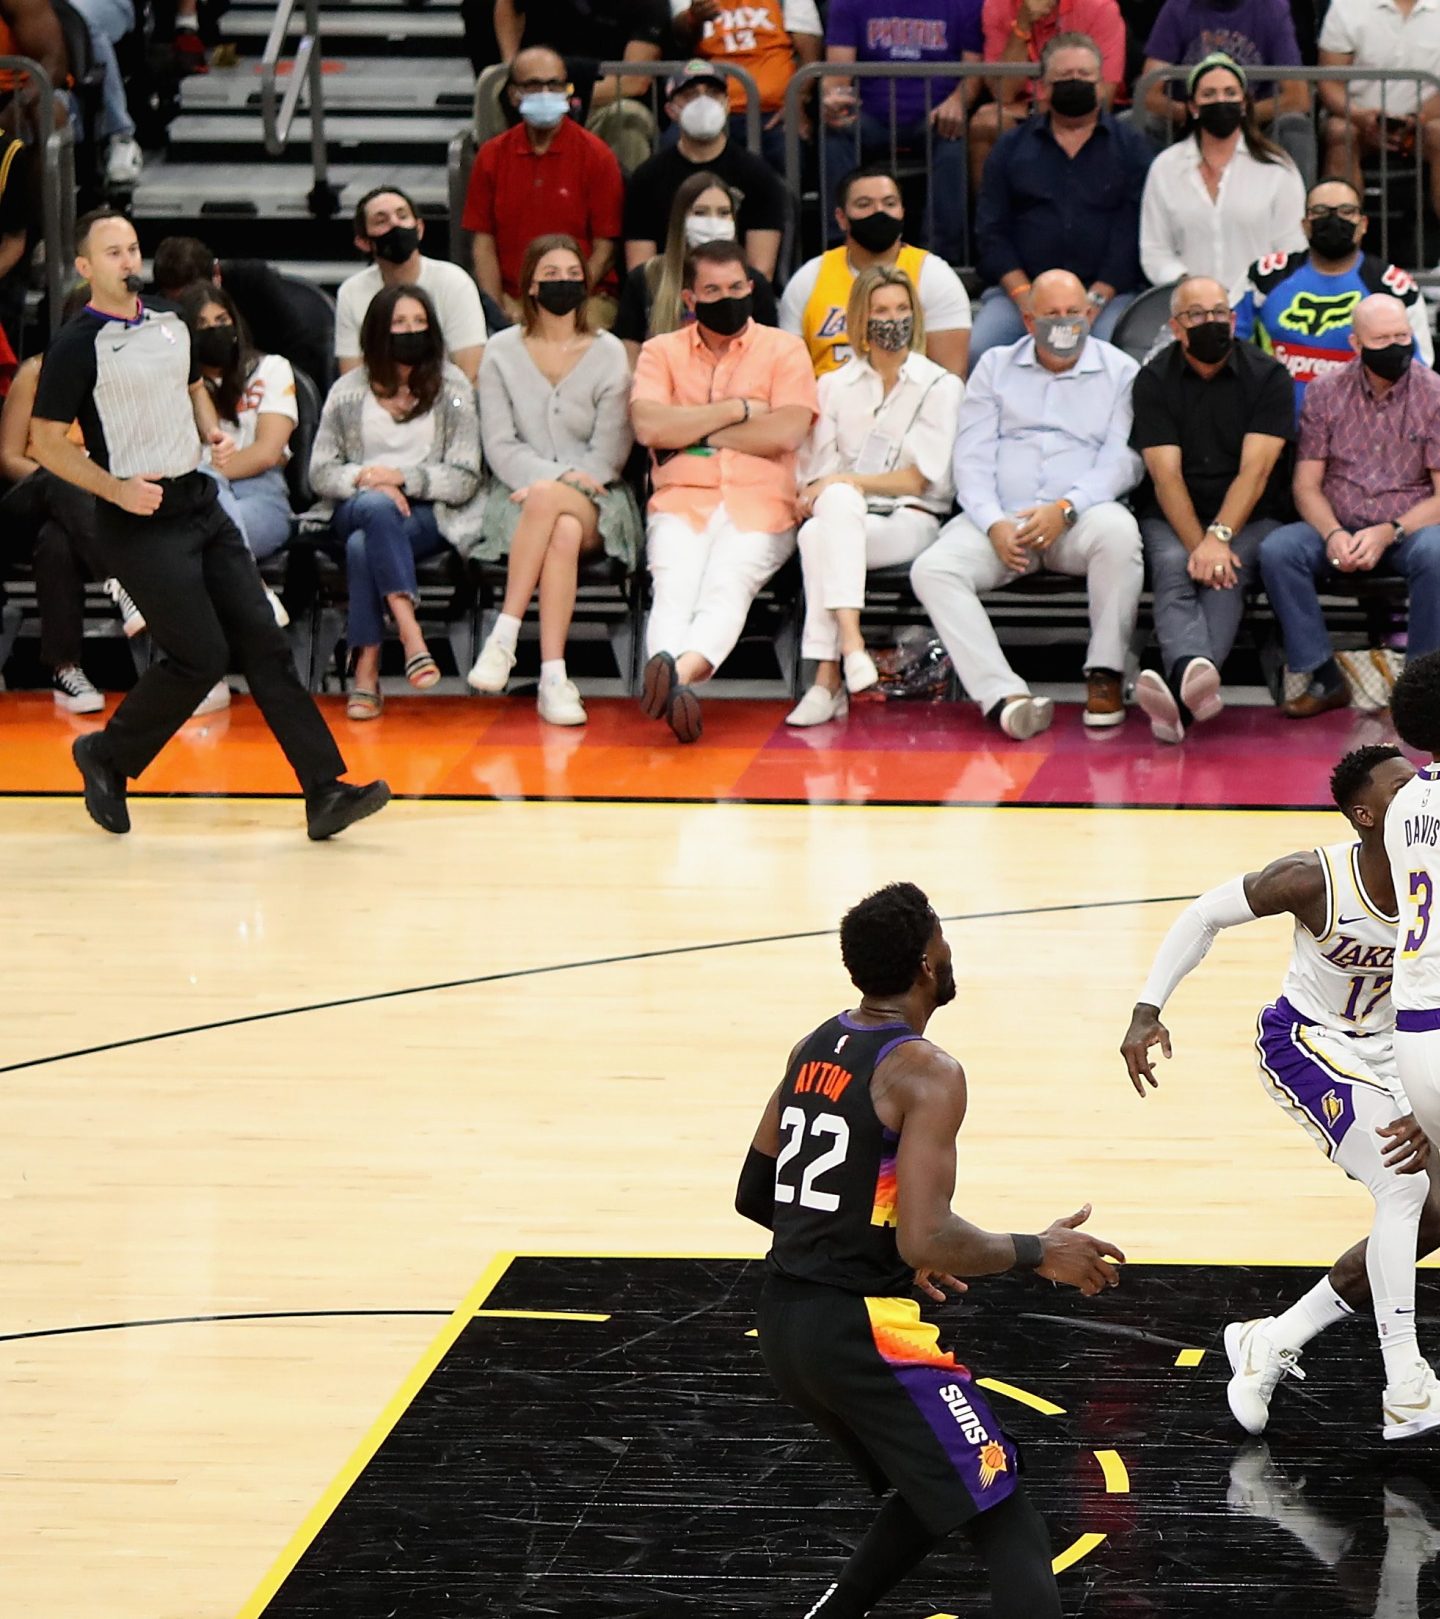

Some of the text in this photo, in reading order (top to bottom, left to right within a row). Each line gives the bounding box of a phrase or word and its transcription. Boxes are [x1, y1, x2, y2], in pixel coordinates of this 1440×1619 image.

[1404, 814, 1440, 848] DAVIS
[1400, 868, 1434, 959] 3
[1340, 973, 1393, 1024] 17
[794, 1060, 853, 1103] AYTON
[774, 1106, 850, 1212] 22
[939, 1384, 989, 1445] SUNS
